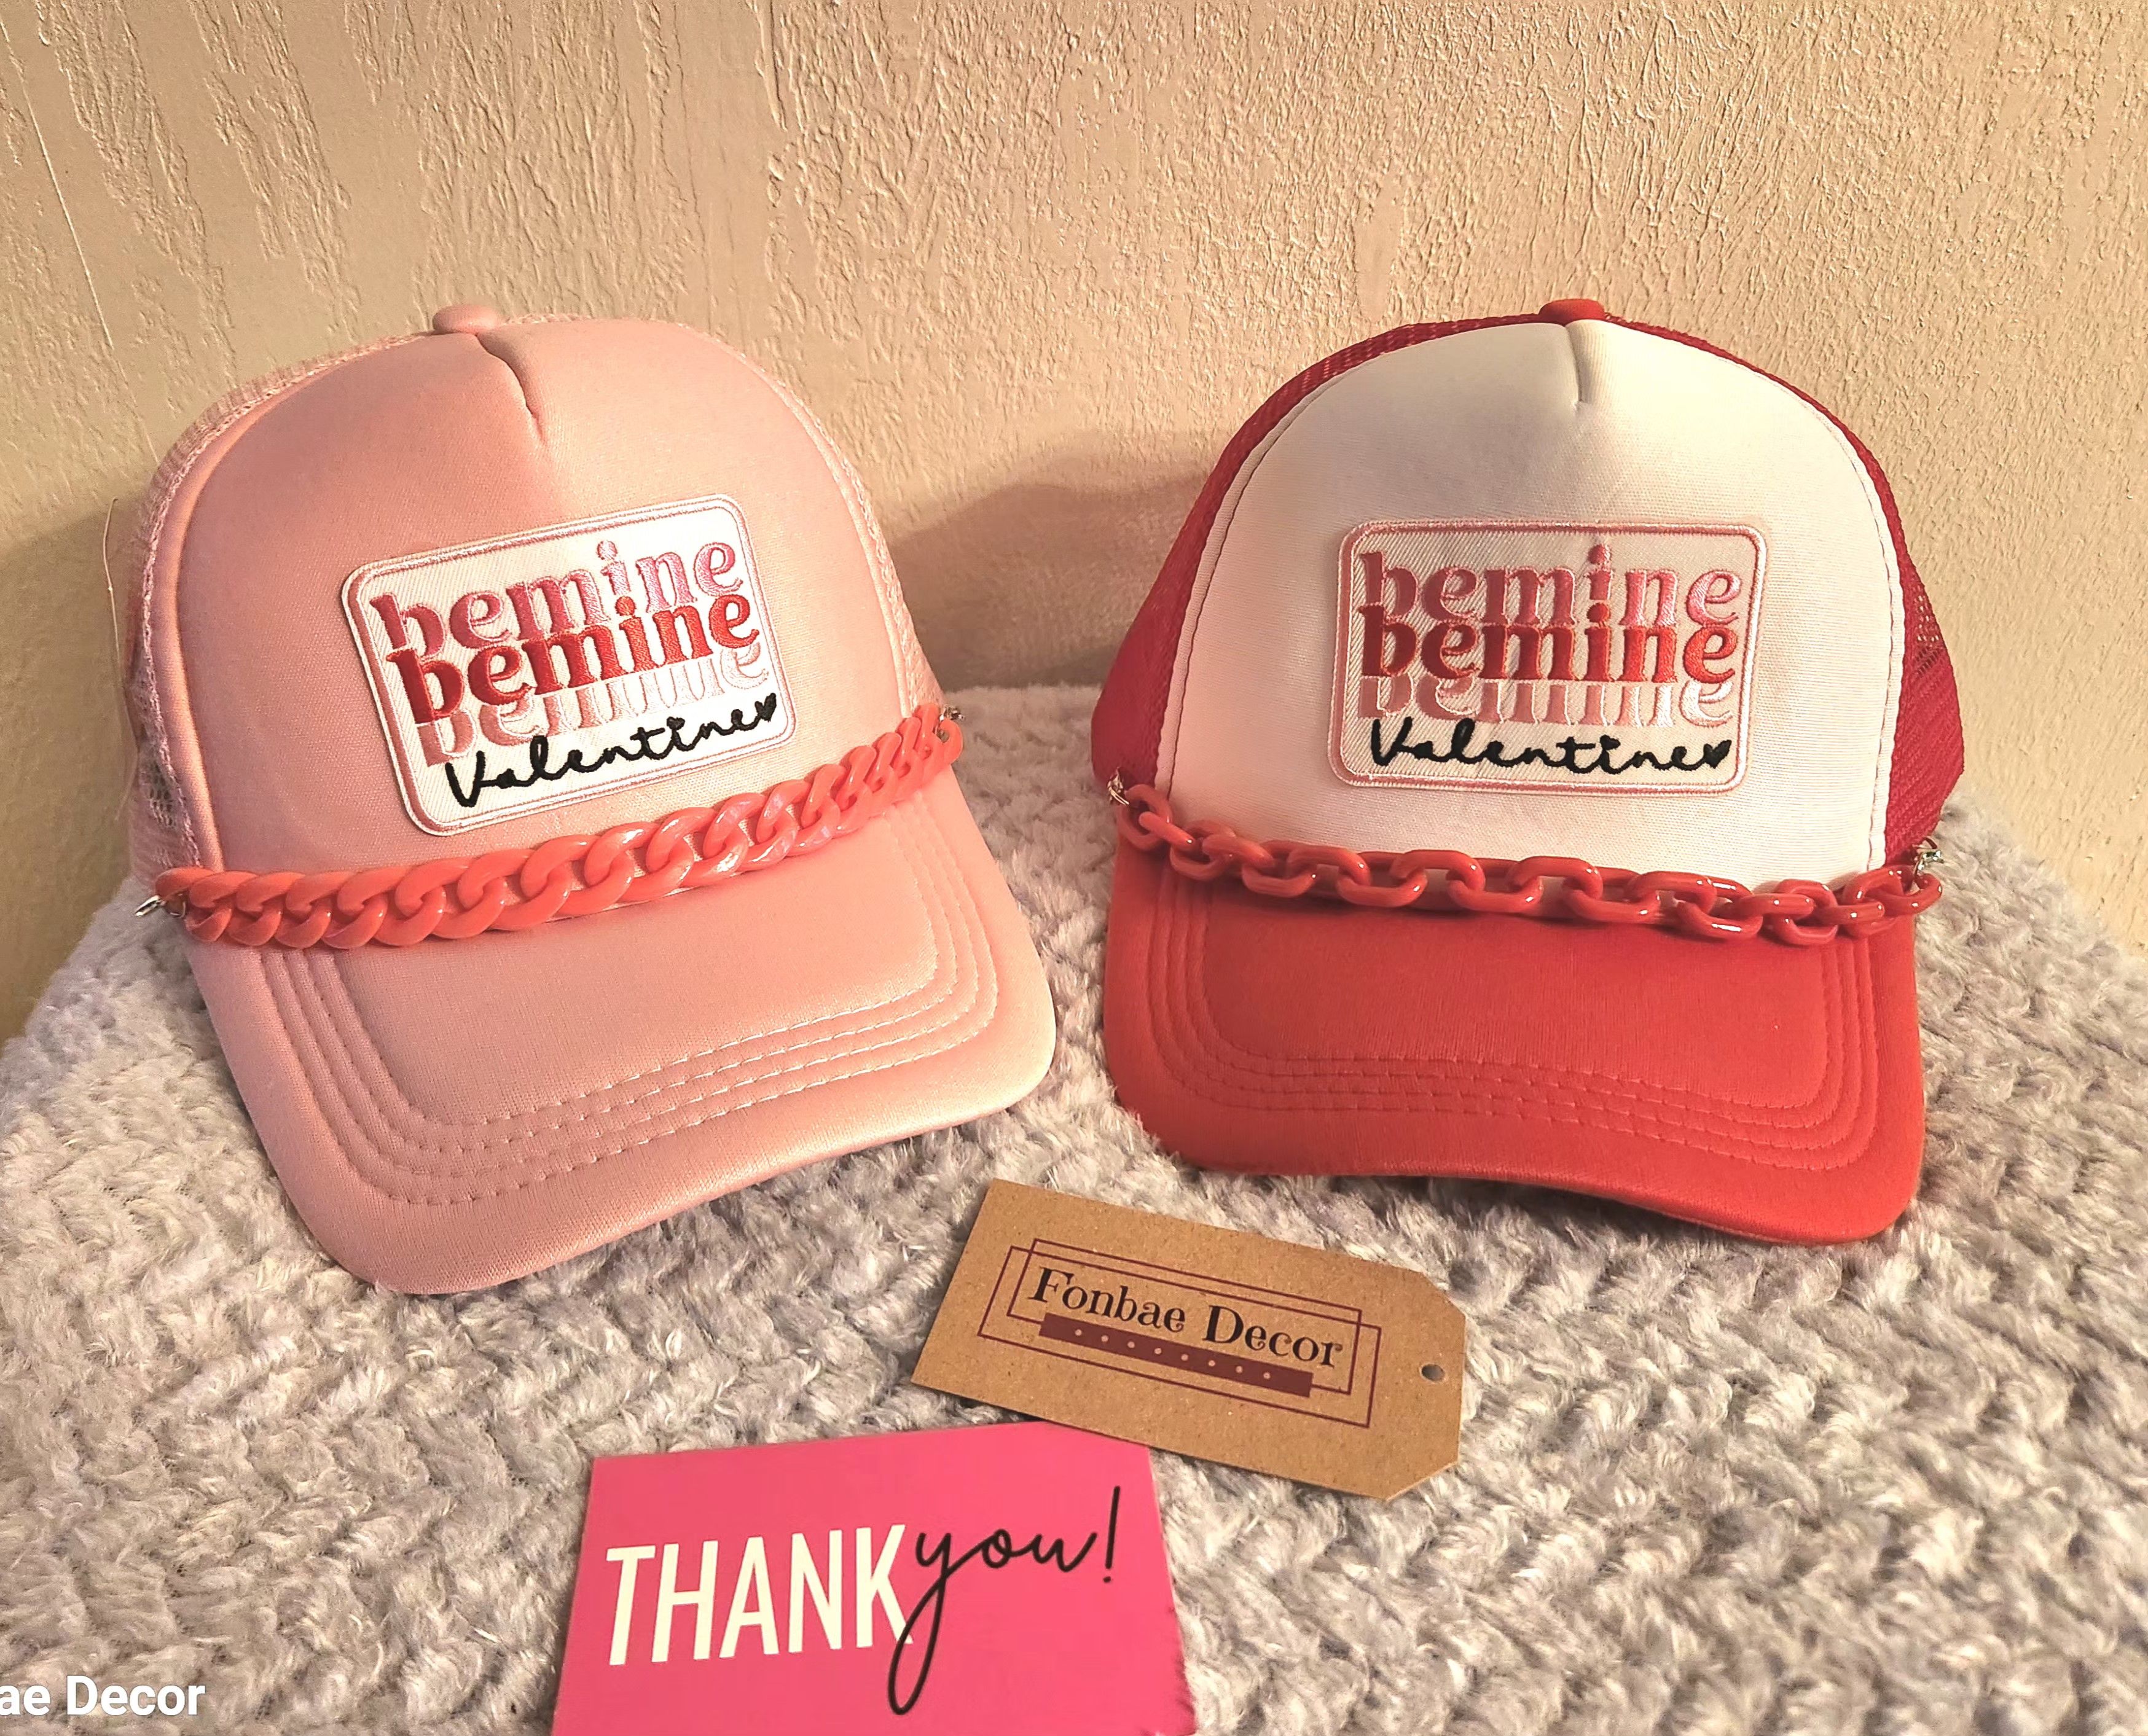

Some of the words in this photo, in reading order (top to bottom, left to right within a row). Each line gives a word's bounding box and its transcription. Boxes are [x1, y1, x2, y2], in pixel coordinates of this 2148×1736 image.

[369, 539, 743, 658] bemine
[1360, 544, 1742, 627] bemine
[386, 593, 760, 725] bemine
[1358, 603, 1738, 684] bemine
[444, 707, 756, 808] Valentine
[1370, 717, 1705, 775] Valentine
[1028, 1266, 1186, 1334] Fonbae
[1202, 1304, 1344, 1369] Decor
[605, 1523, 913, 1666] THANK
[887, 1486, 1121, 1715] you!
